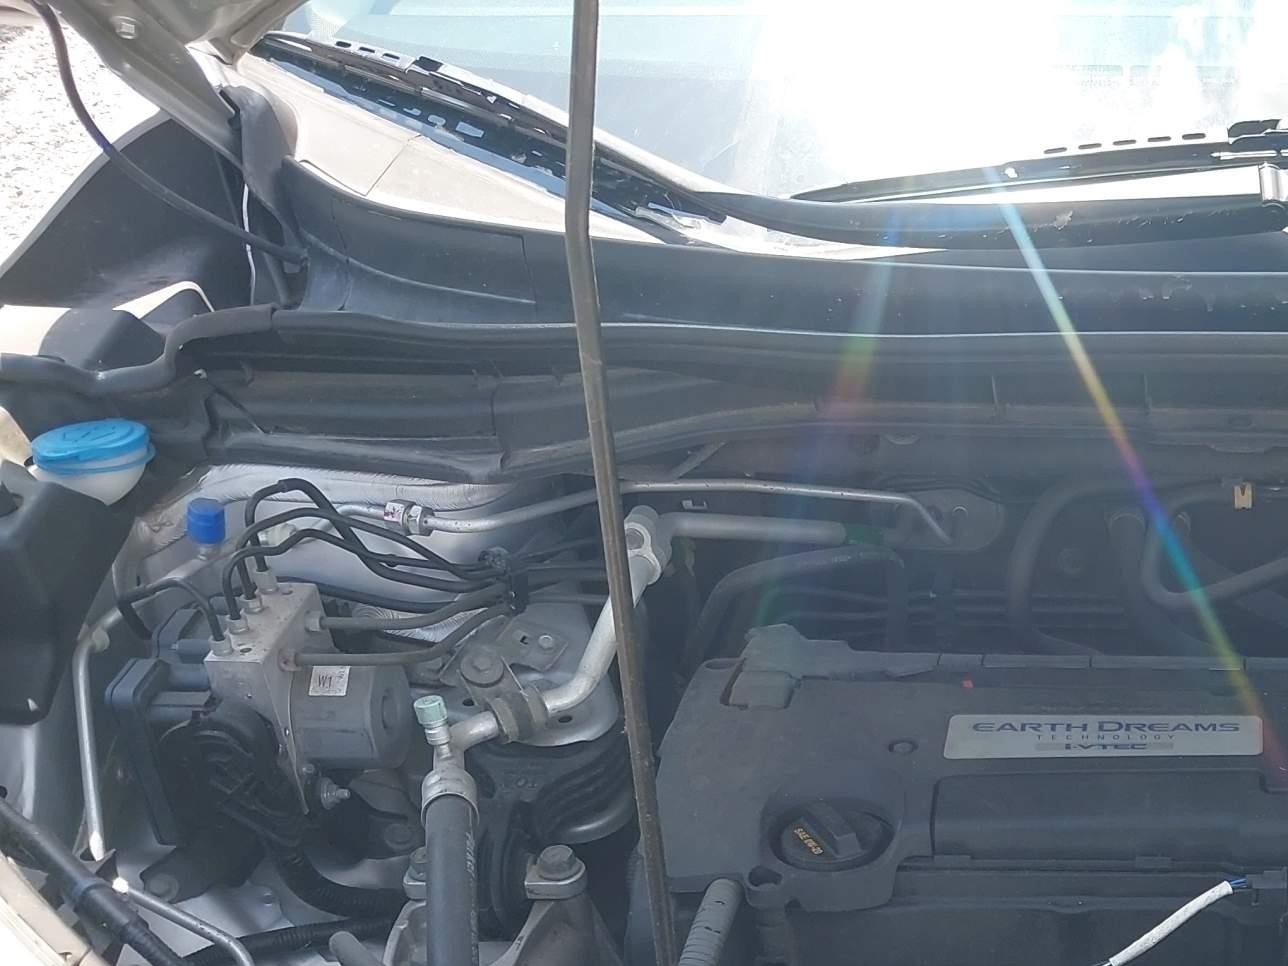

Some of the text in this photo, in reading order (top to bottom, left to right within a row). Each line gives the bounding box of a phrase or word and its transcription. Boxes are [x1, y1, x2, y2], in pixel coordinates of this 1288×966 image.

[972, 720, 1241, 732] EARTH DREAMS
[1064, 742, 1148, 751] i-VTEC
